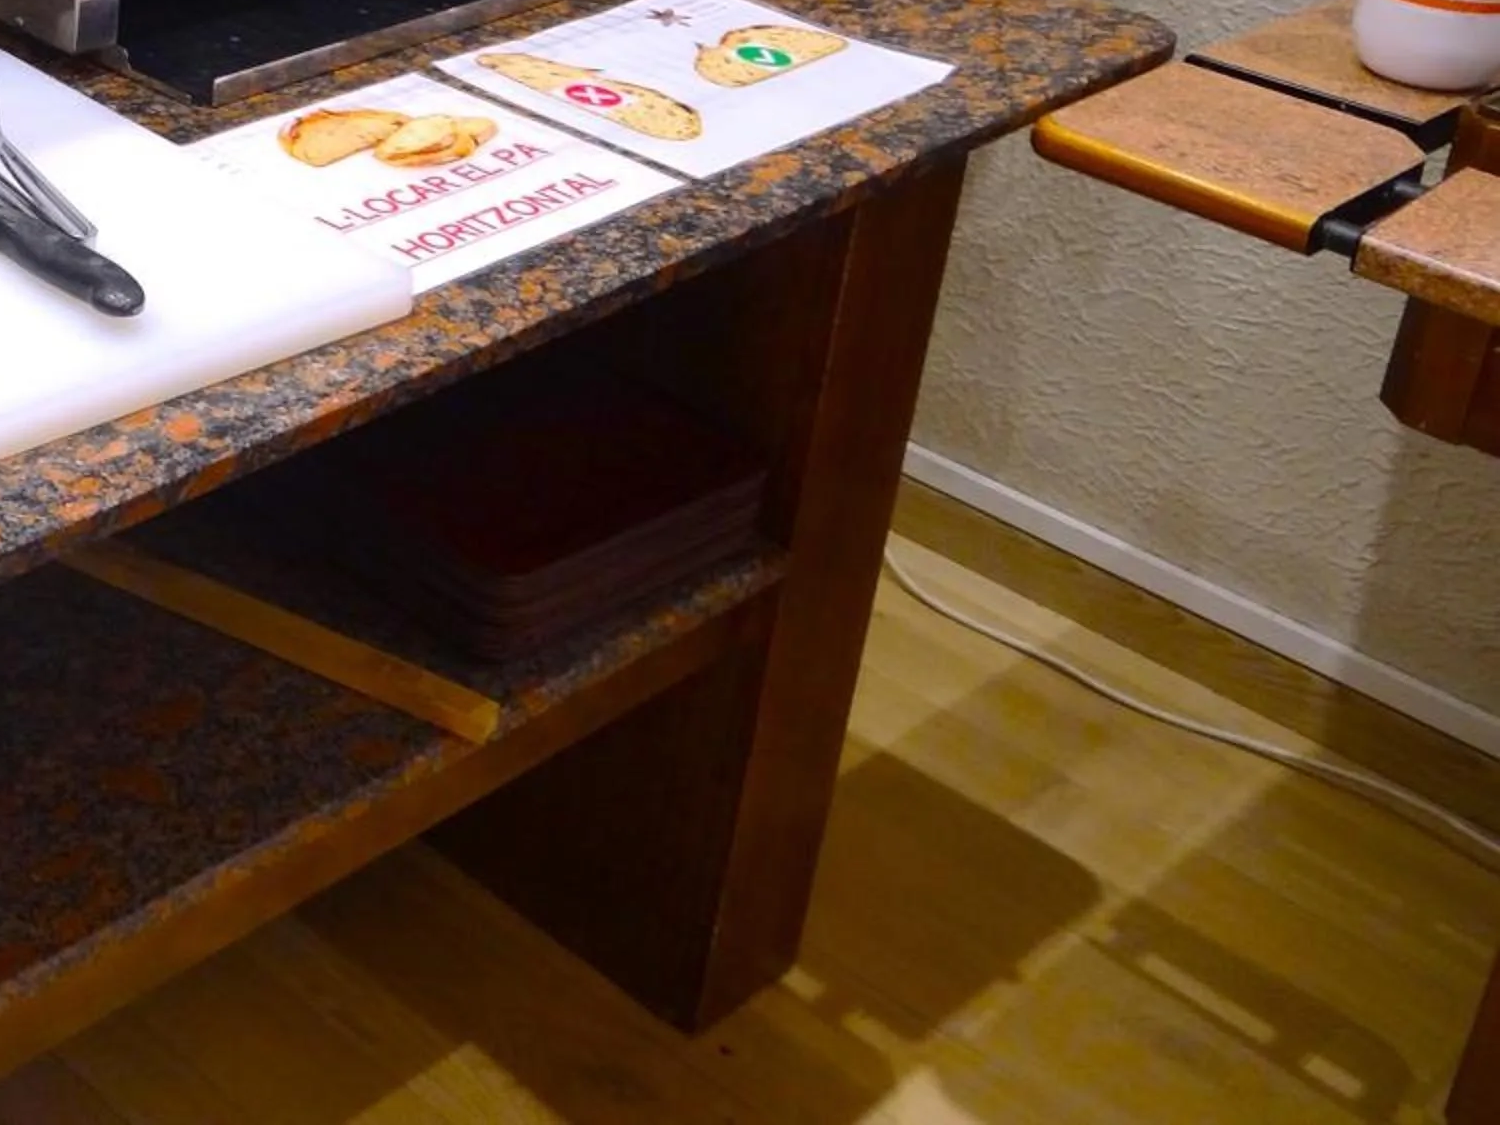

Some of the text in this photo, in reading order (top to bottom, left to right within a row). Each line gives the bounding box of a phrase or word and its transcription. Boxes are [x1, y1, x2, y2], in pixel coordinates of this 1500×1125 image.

[450, 162, 504, 183] EL
[490, 142, 550, 166] PA
[390, 172, 617, 261] HORITZONTAL
